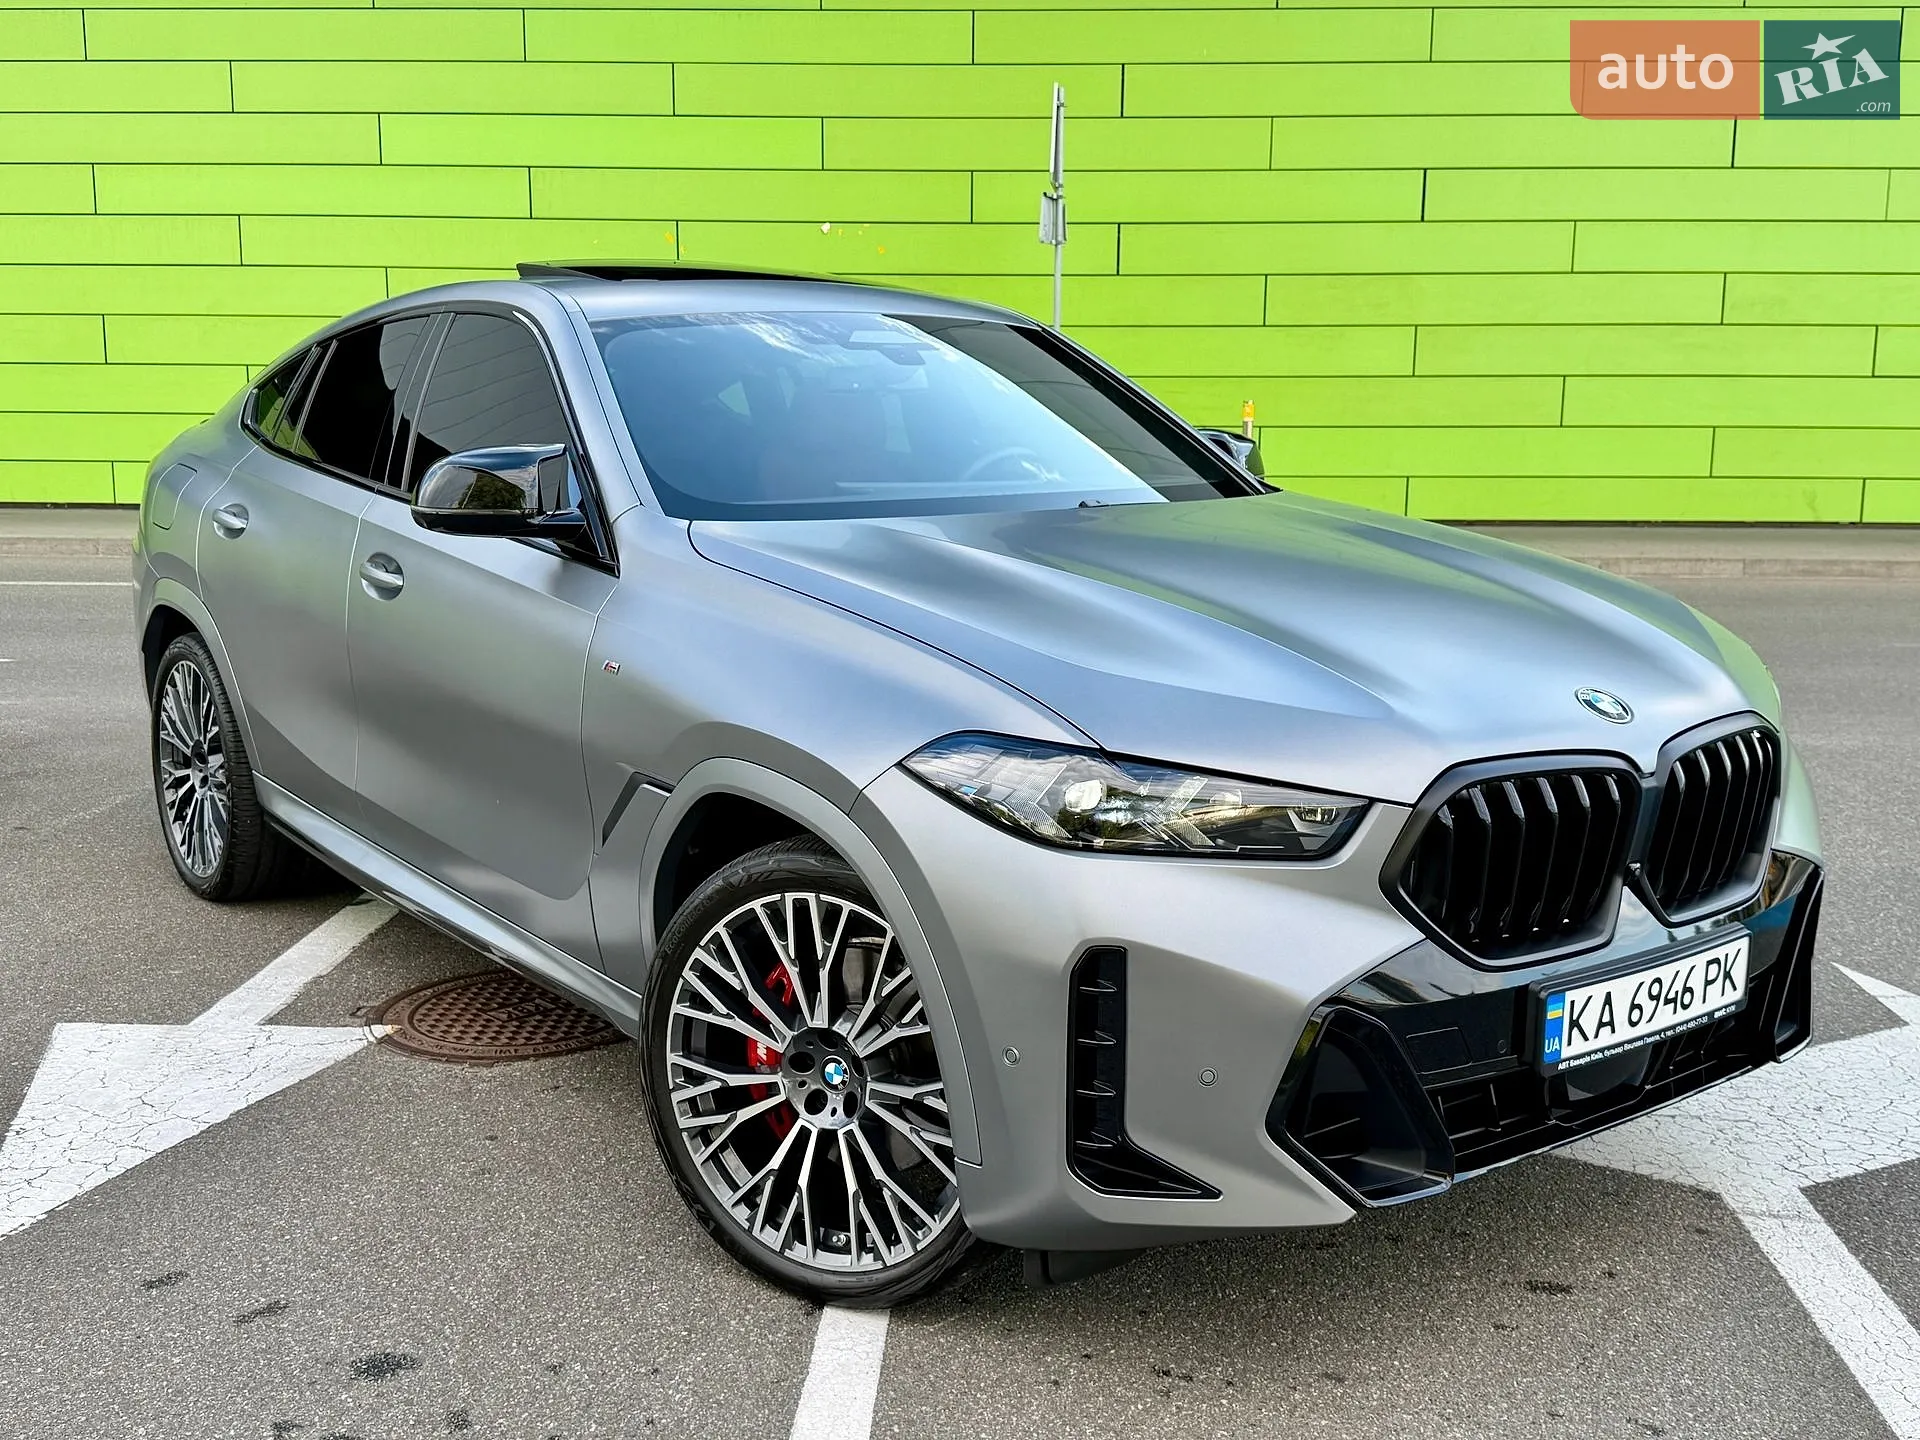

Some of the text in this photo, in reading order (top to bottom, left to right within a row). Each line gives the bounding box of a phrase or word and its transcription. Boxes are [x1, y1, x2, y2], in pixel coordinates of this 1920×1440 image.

[1567, 948, 1742, 1047] KA 6946 PK
[1545, 1036, 1560, 1053] UA
